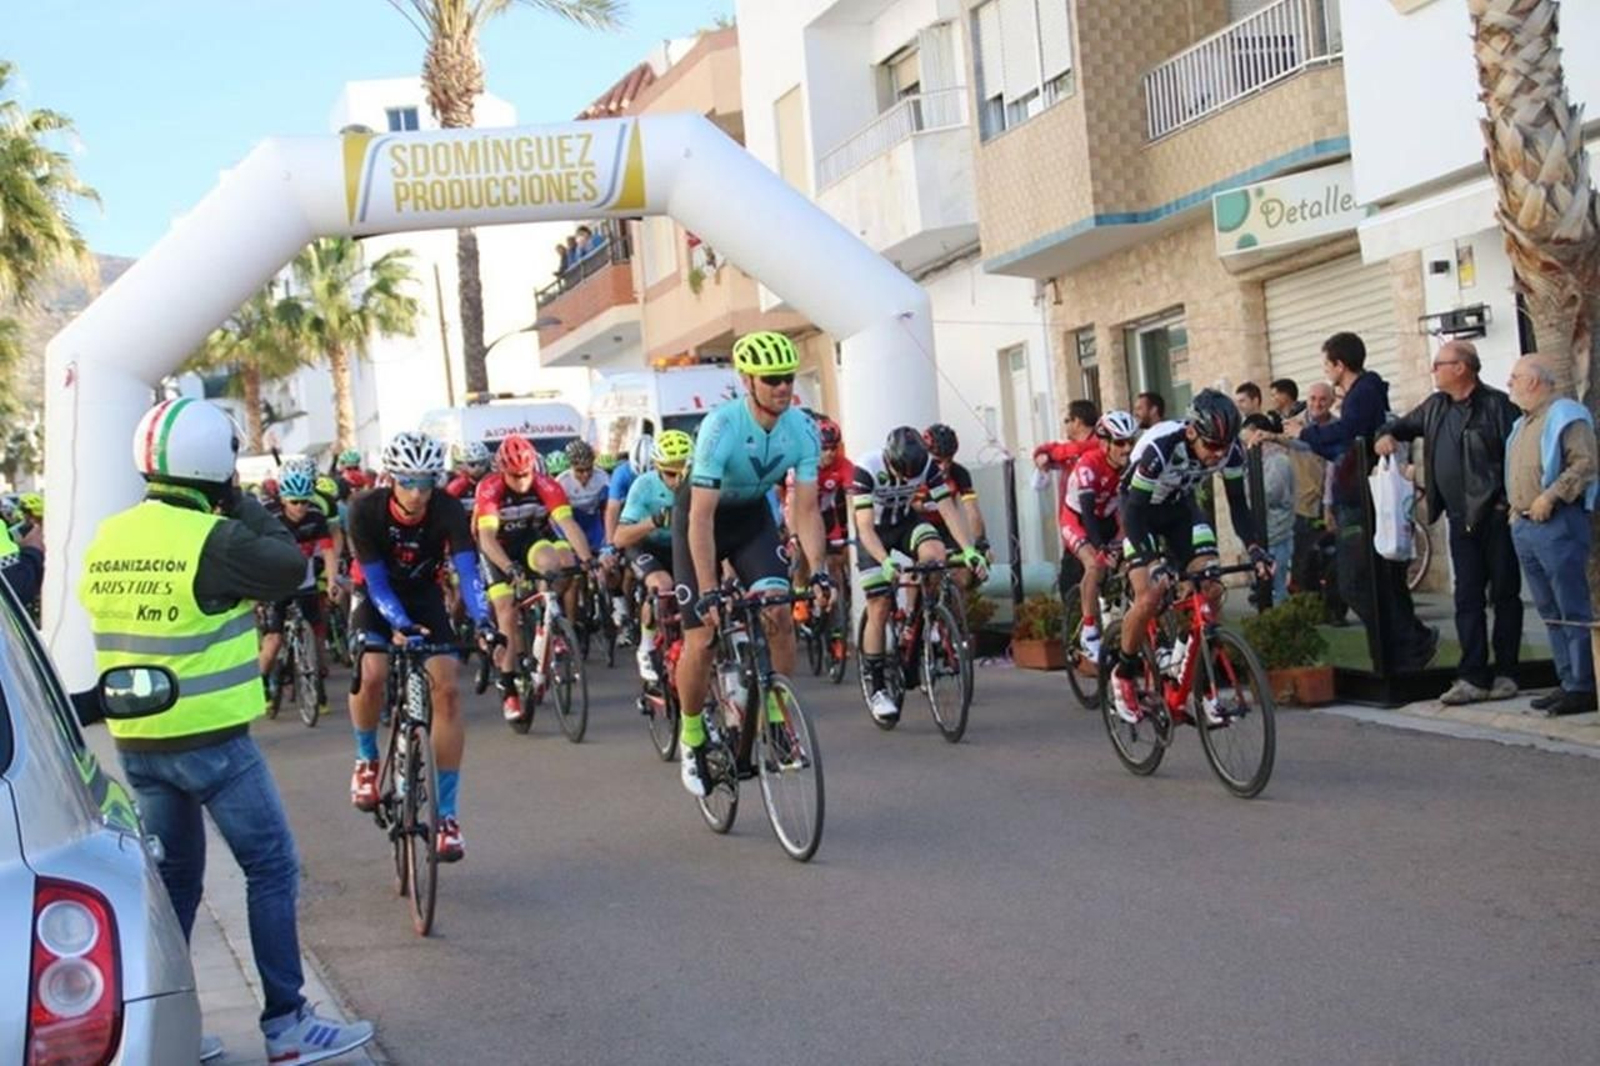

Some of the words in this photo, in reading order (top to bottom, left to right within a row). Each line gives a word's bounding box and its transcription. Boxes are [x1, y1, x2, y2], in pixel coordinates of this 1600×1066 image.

[390, 133, 595, 179] SDOMÍNGUEZ
[394, 171, 598, 212] PRODUCCIONES
[1261, 184, 1358, 229] Detalle
[90, 580, 173, 595] ARISTIDES
[136, 604, 162, 621] Km
